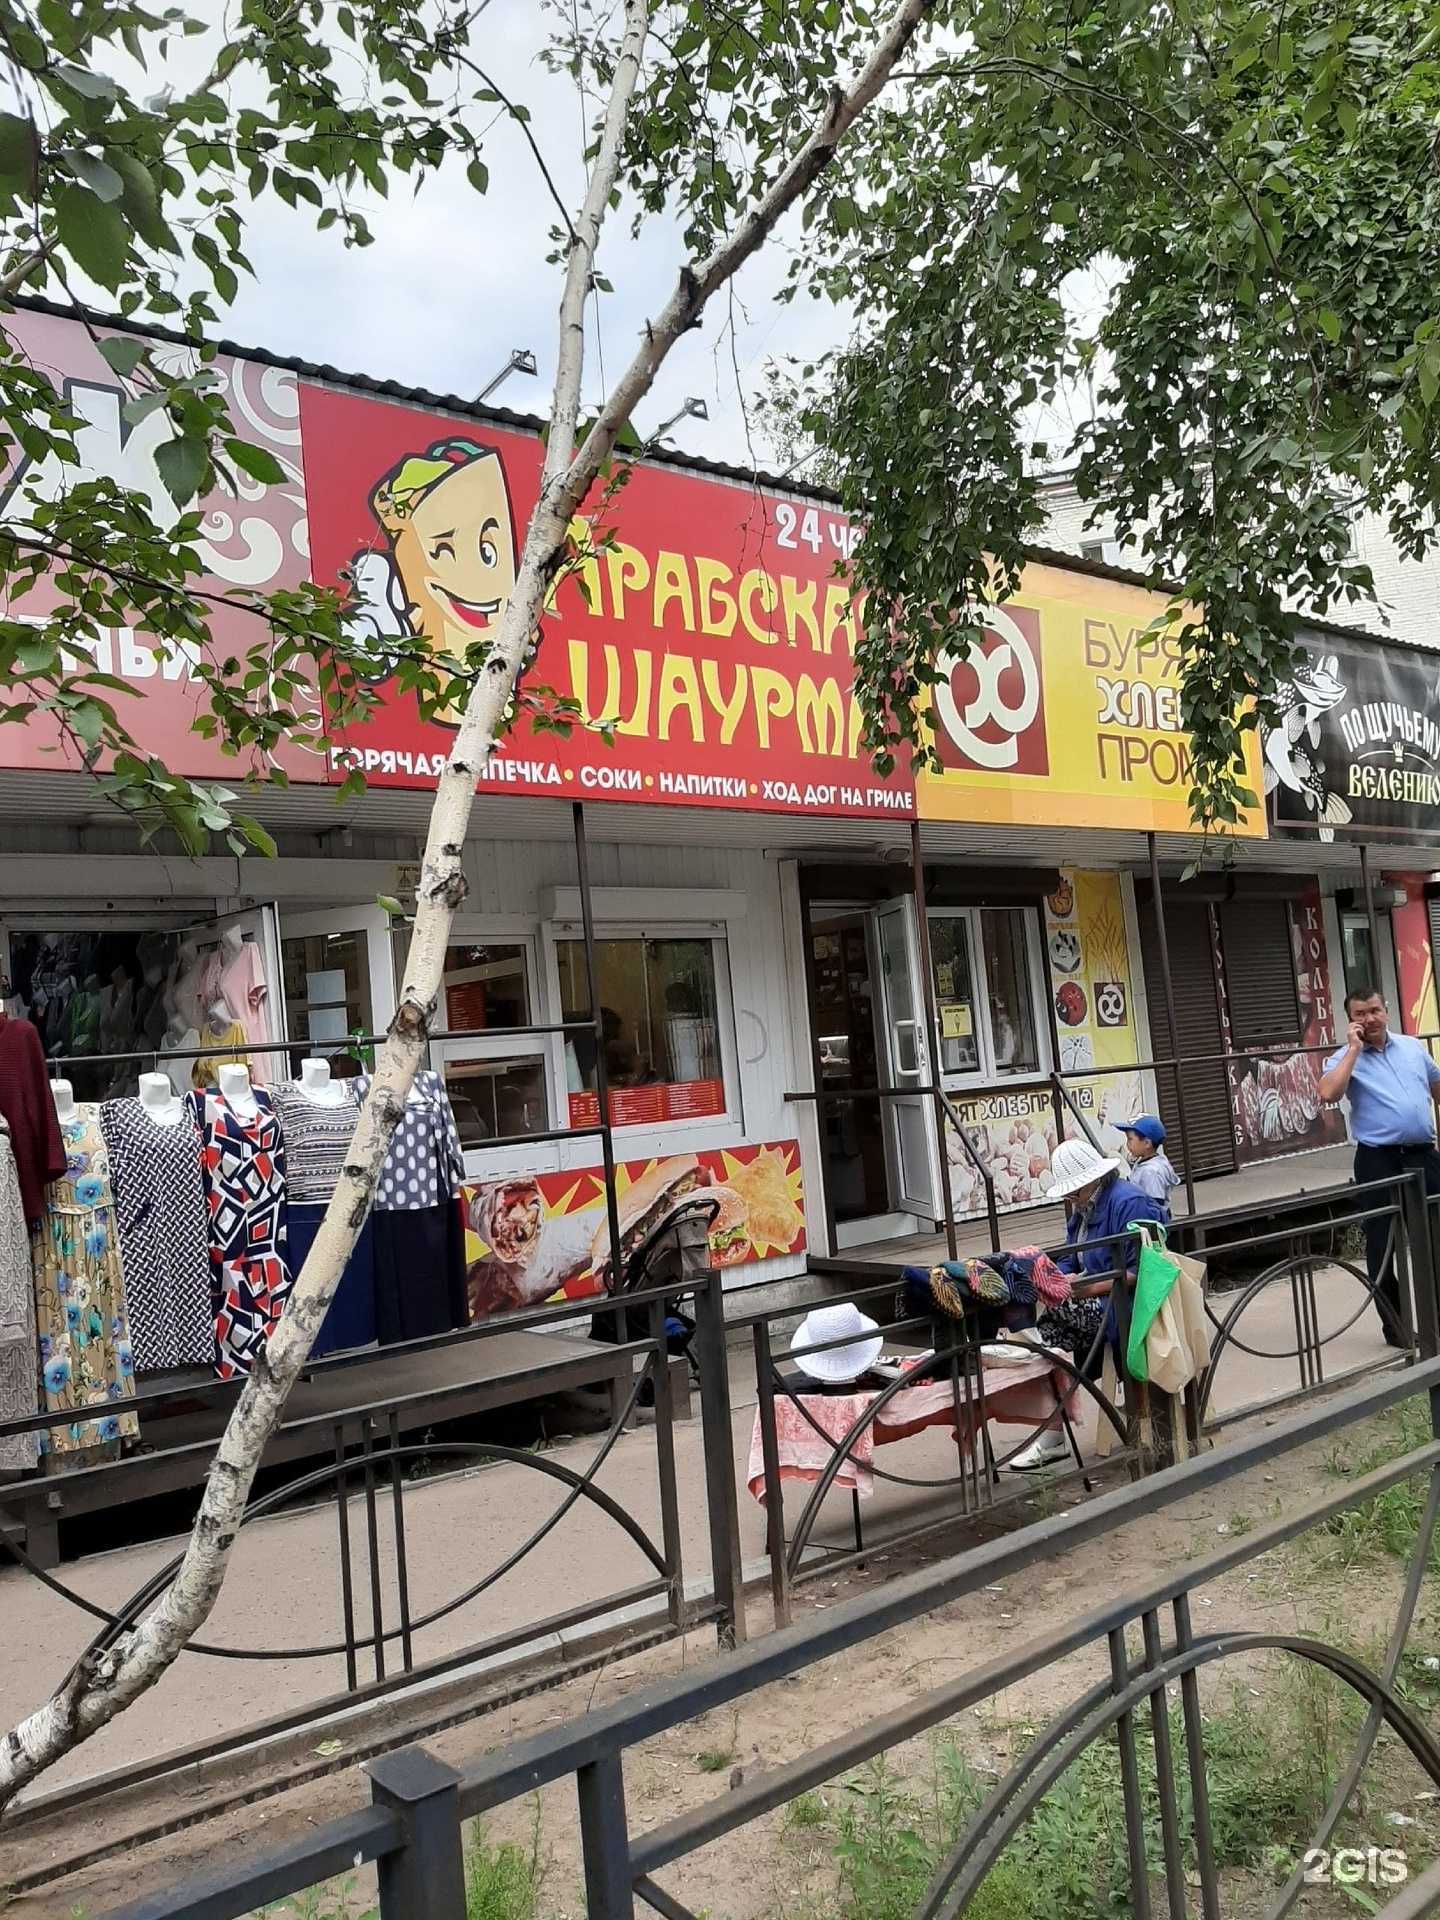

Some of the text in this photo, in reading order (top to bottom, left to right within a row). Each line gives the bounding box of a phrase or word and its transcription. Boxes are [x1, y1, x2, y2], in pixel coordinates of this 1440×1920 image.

[775, 503, 823, 554] 24
[543, 514, 870, 658] АРАБСКА
[1084, 619, 1184, 678] БУРЯ
[1097, 676, 1184, 732] ХЛЕ
[1340, 708, 1366, 752] ПО
[481, 757, 562, 785] ПЕЧКА
[580, 765, 642, 790] СОКИ
[659, 772, 747, 798] НАПИТКИ
[762, 780, 801, 805] ХОД
[804, 783, 837, 806] ДОГ
[841, 786, 863, 807] НА
[866, 789, 913, 810] ГРИЛЕ
